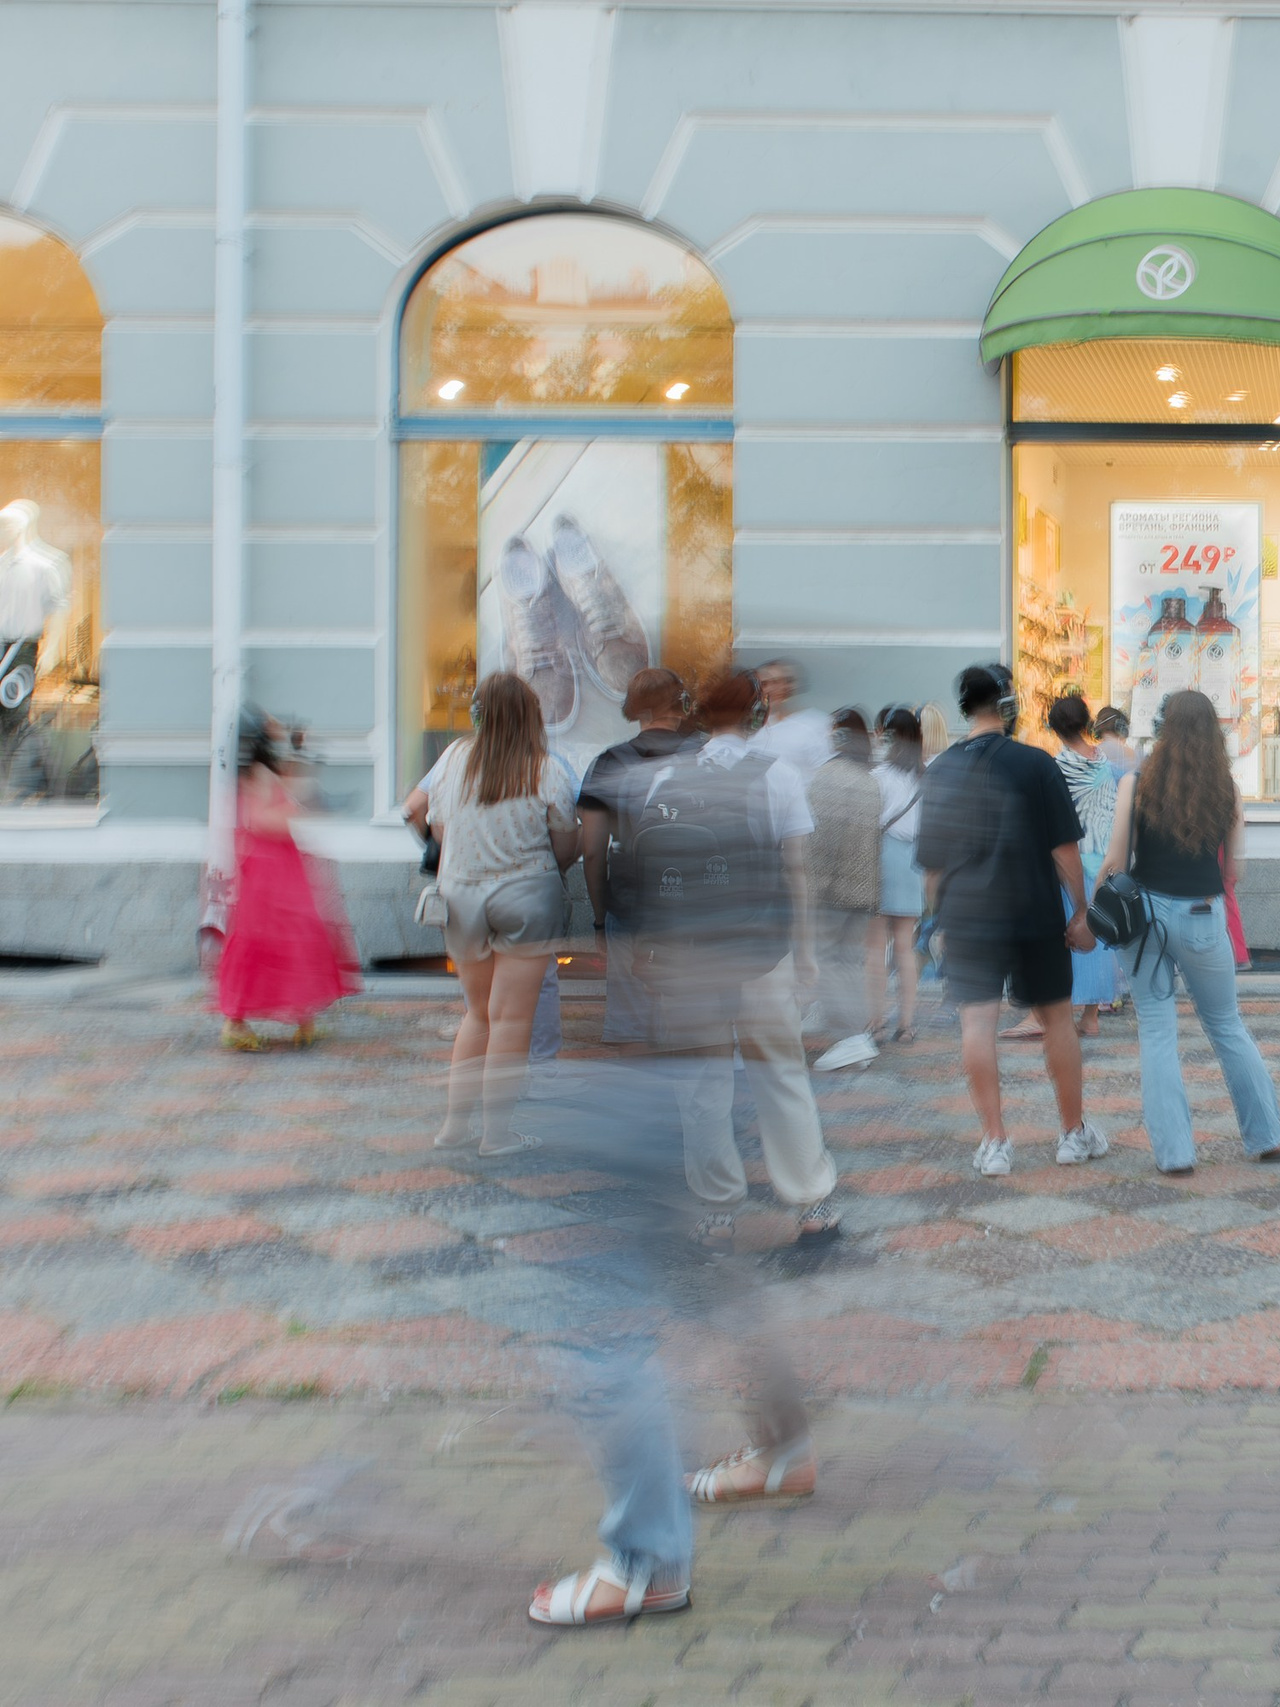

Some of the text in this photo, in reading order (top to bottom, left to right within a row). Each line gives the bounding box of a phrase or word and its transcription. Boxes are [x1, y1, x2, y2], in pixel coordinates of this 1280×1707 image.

[1118, 512, 1220, 522] АРОМАТЫ РЕГИОНА
[1169, 522, 1220, 534] ФРАНЦИЯ
